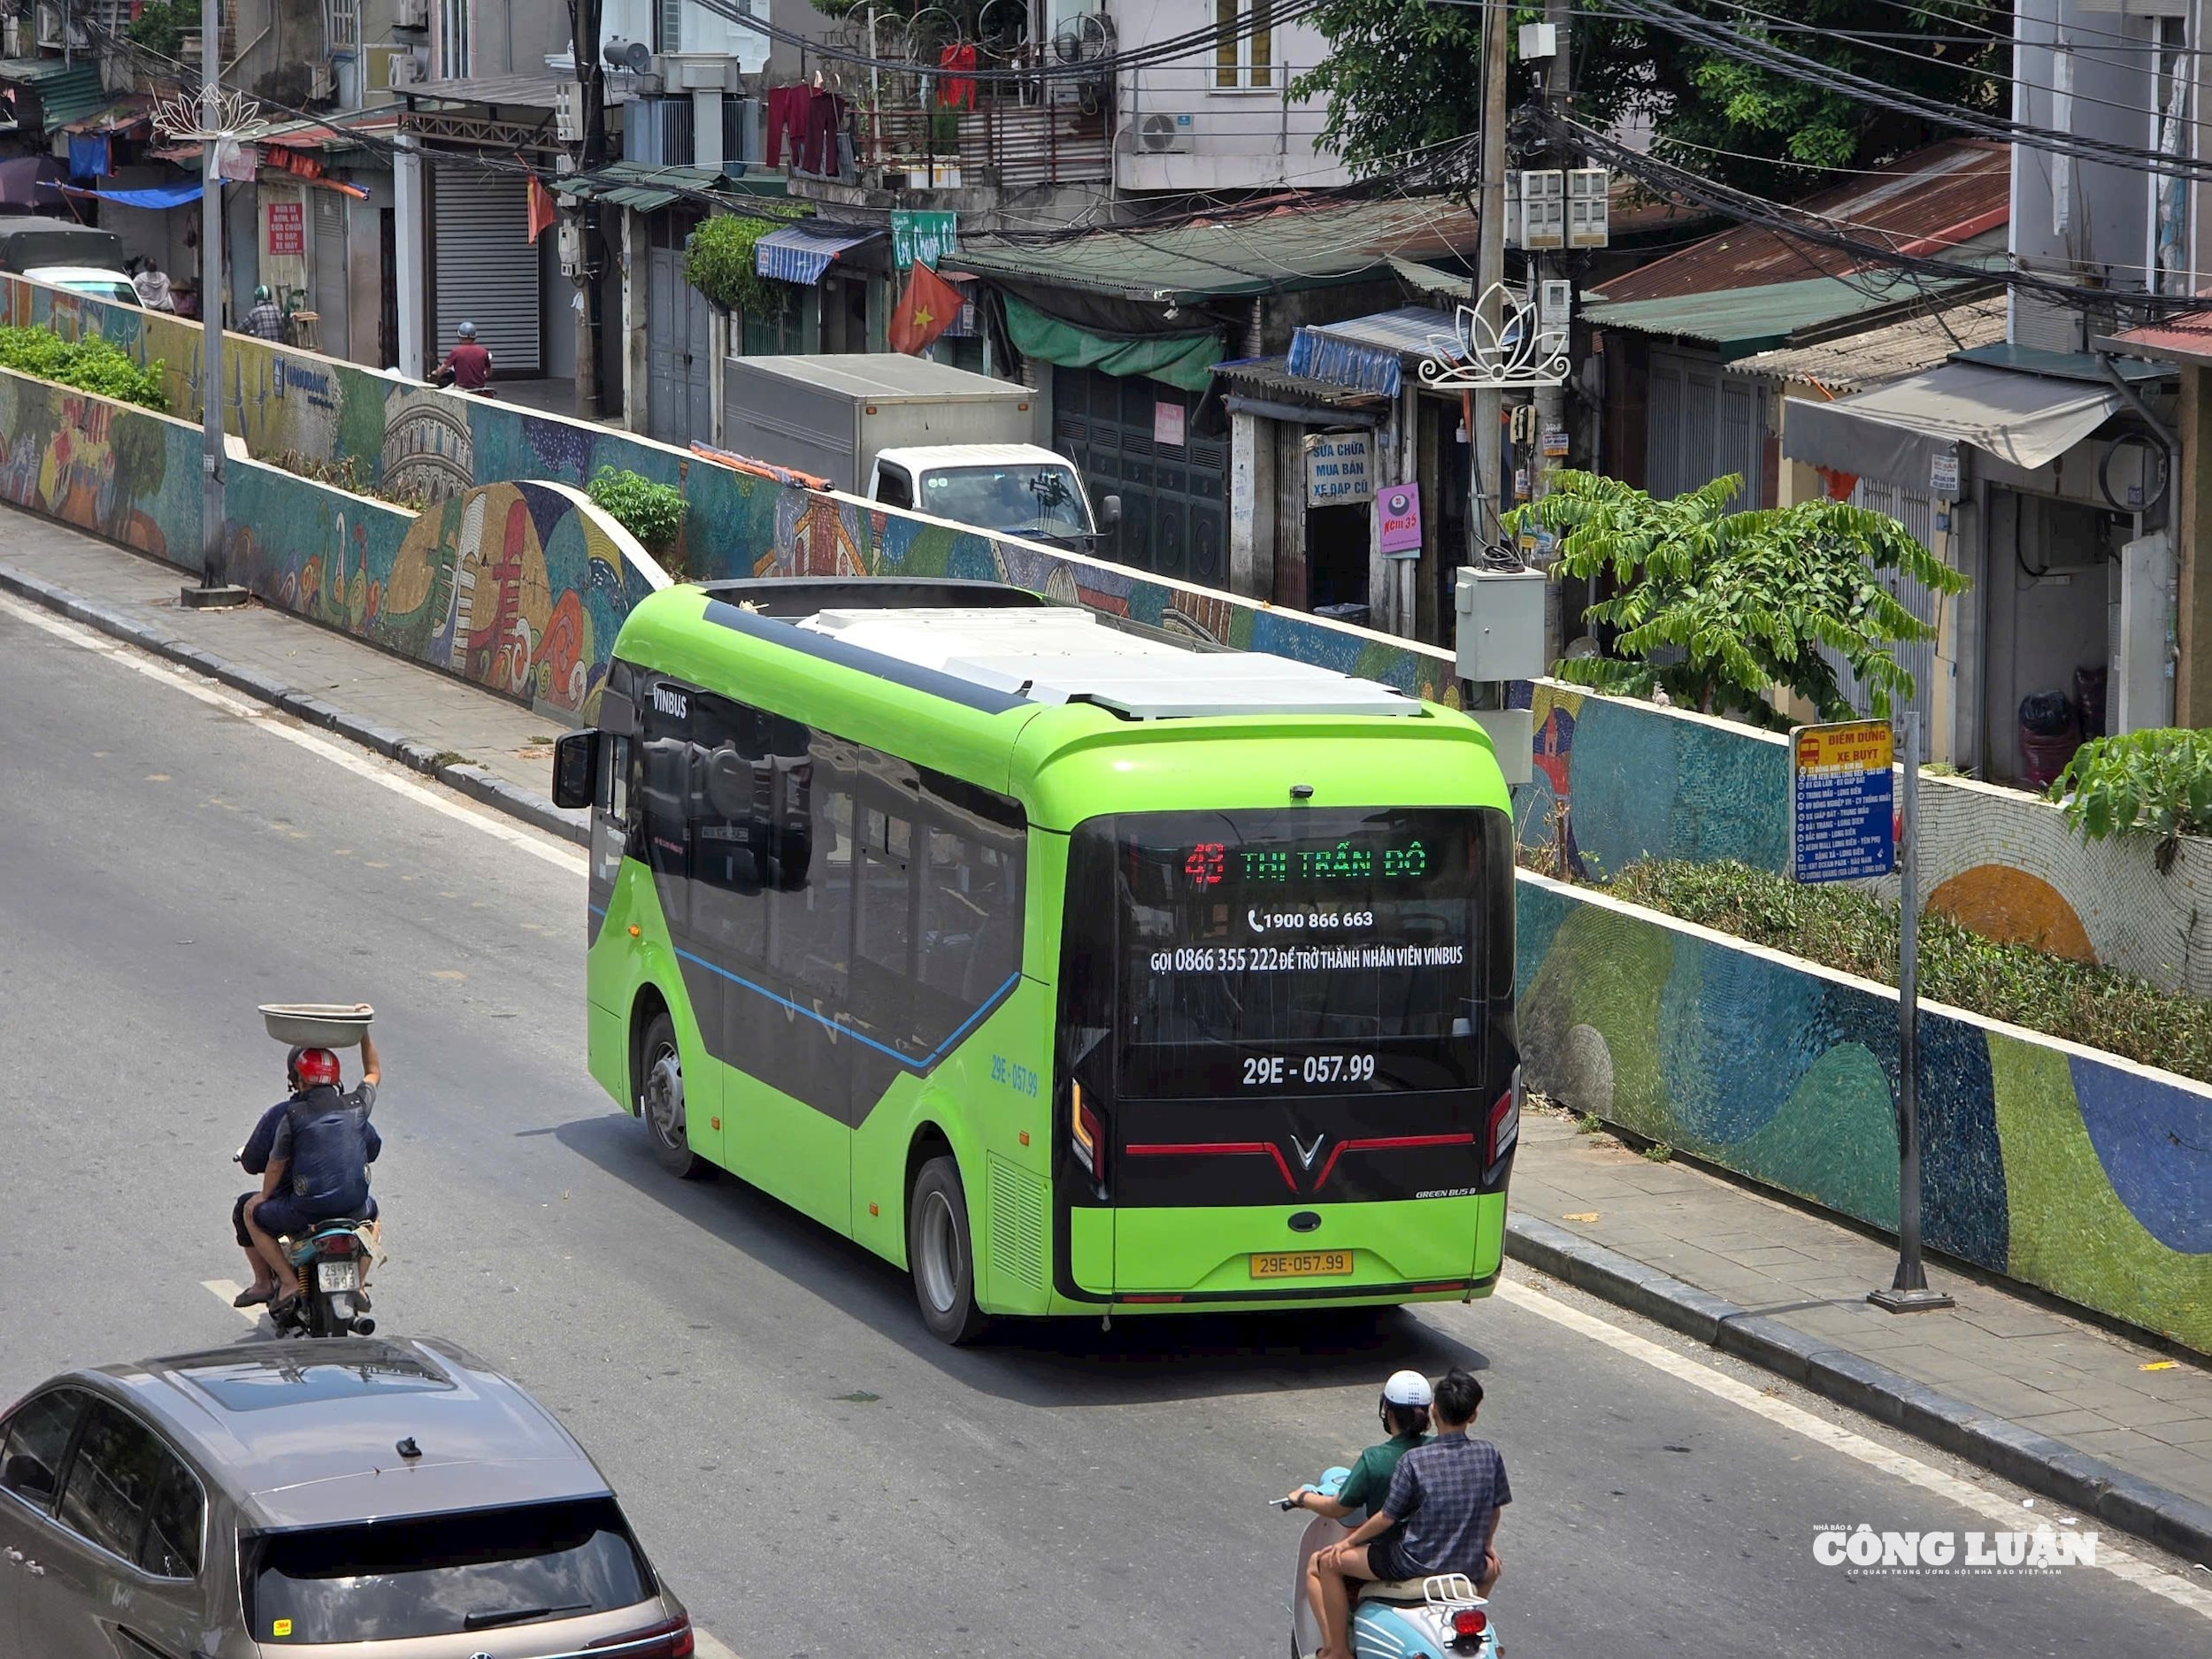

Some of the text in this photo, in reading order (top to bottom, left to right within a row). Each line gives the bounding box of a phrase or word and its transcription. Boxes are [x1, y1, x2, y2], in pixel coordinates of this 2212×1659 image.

[1337, 442, 1365, 456] CHỮA
[1316, 464, 1339, 477] MUA
[1314, 484, 1326, 496] XE
[1330, 482, 1351, 496] ĐẠP
[1405, 512, 1417, 529] 35
[654, 687, 687, 719] VINBUS
[1829, 728, 1886, 746] ĐIỂM DỪNG
[1837, 747, 1878, 763] XE BUÝT
[1240, 852, 1286, 881] THỊ
[1297, 841, 1371, 878] TRẤN
[1263, 910, 1373, 928] 1900 866 663
[1150, 945, 1463, 975] GỌI 0866 355 222 ĐỂ TRỞ THÀNH NHÂN VIÊN VINBUS
[991, 1054, 1006, 1084] 29E
[1012, 1063, 1038, 1098] 057.99
[1243, 1057, 1284, 1084] 29E
[1303, 1054, 1375, 1083] 057.99
[1416, 1189, 1448, 1199] GREEN
[1448, 1187, 1469, 1196] BUS
[1260, 1255, 1344, 1273] 29E-057.99
